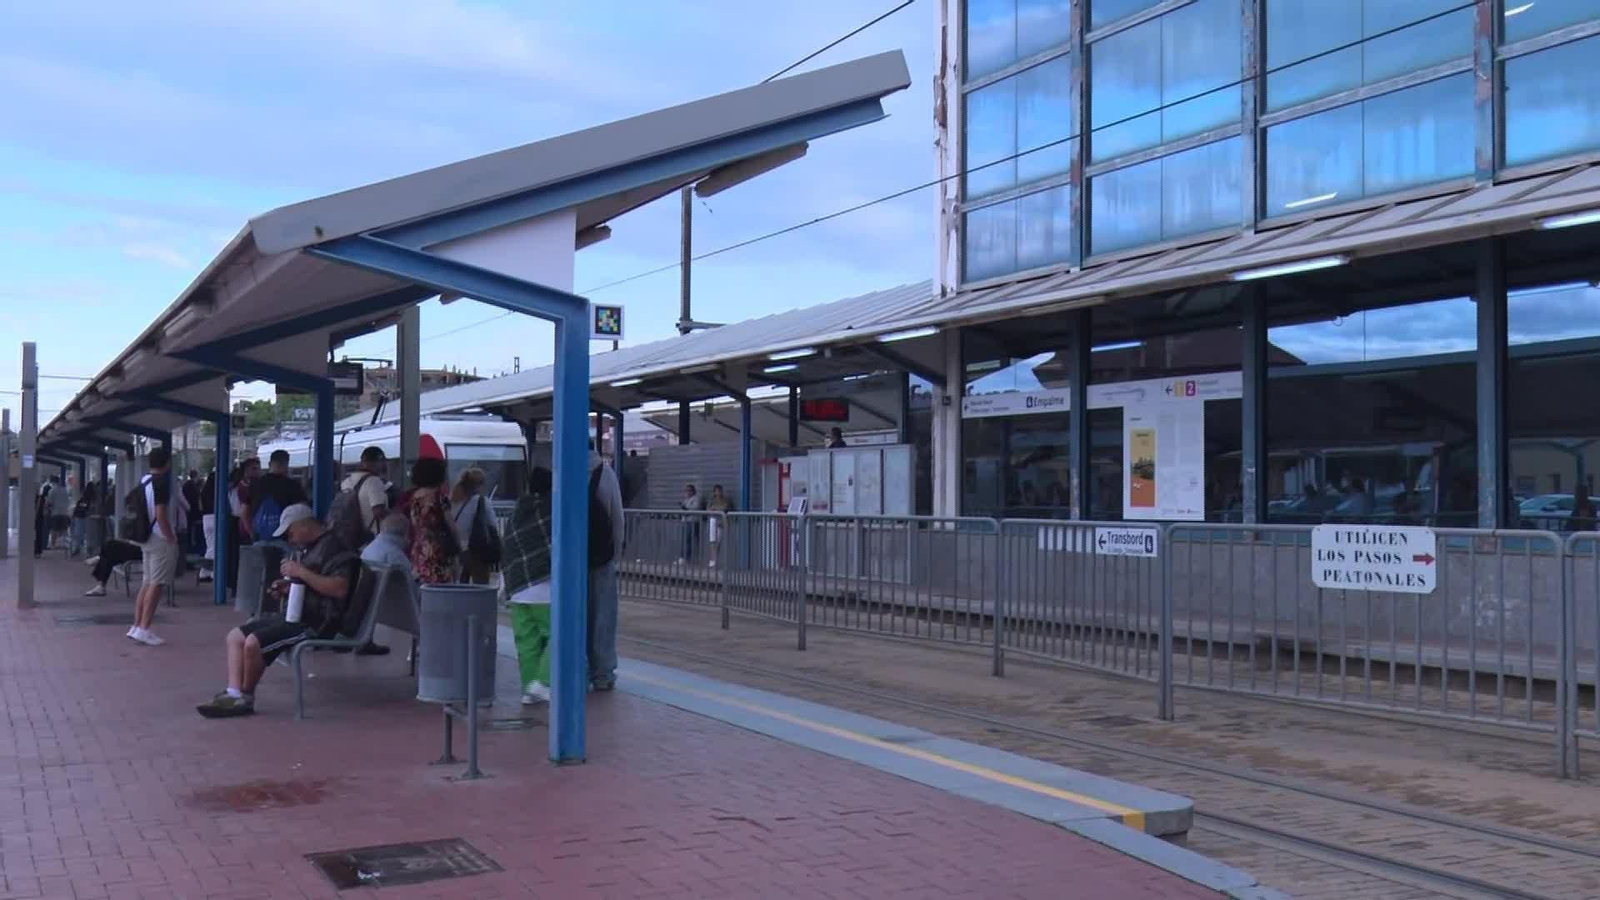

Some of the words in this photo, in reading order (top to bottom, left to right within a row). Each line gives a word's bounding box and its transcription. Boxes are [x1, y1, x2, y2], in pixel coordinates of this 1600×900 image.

[1107, 531, 1144, 545] Transbord
[1335, 530, 1408, 545] UTILICEN
[1318, 548, 1345, 561] LOS
[1354, 550, 1402, 564] PASOS
[1323, 569, 1426, 587] PEATONALES
